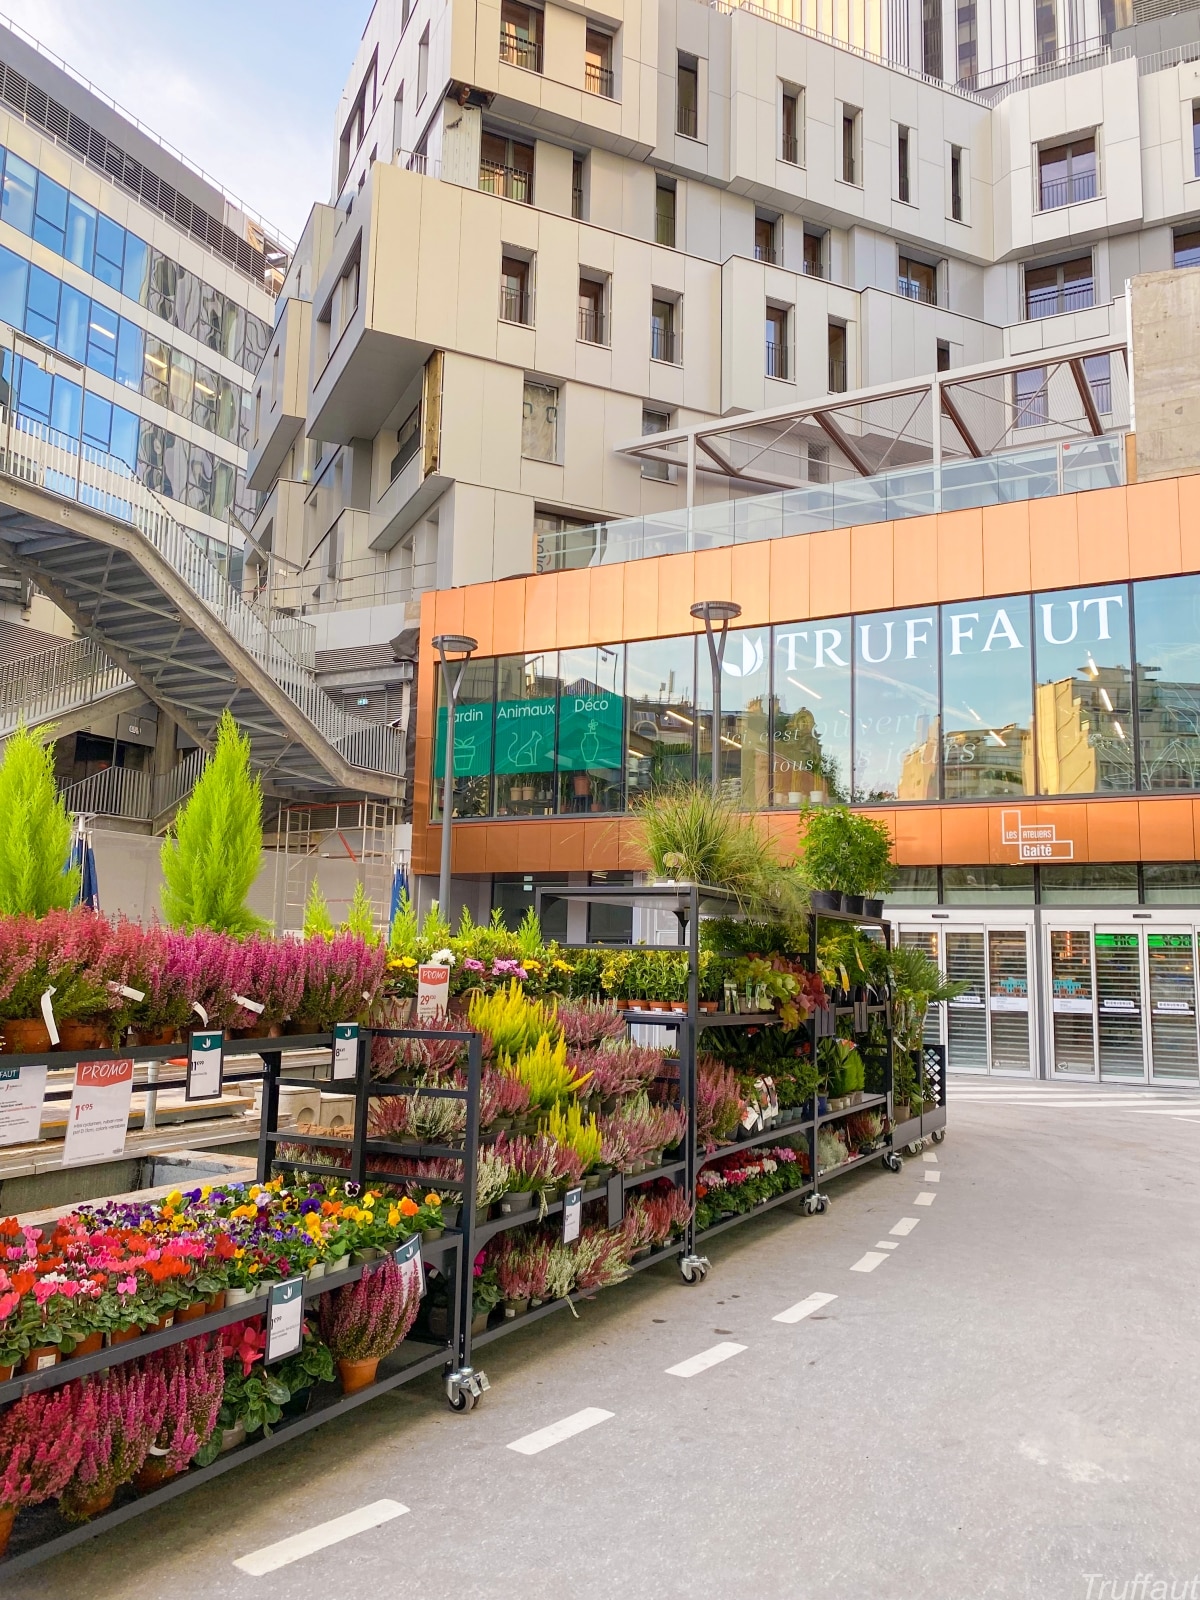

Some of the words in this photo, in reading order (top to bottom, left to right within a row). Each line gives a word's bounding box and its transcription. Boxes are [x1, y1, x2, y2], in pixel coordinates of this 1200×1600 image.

[776, 595, 1124, 672] TRUFFAUT
[497, 702, 556, 719] Animaux
[574, 698, 609, 714] Déco
[448, 707, 483, 724] ardin
[759, 728, 800, 743] cest
[811, 710, 921, 740] ouvert
[773, 759, 815, 774] tous
[879, 741, 977, 774] jours
[422, 970, 447, 980] PROMO
[81, 1062, 129, 1080] PROMO
[75, 1103, 94, 1121] 1€95
